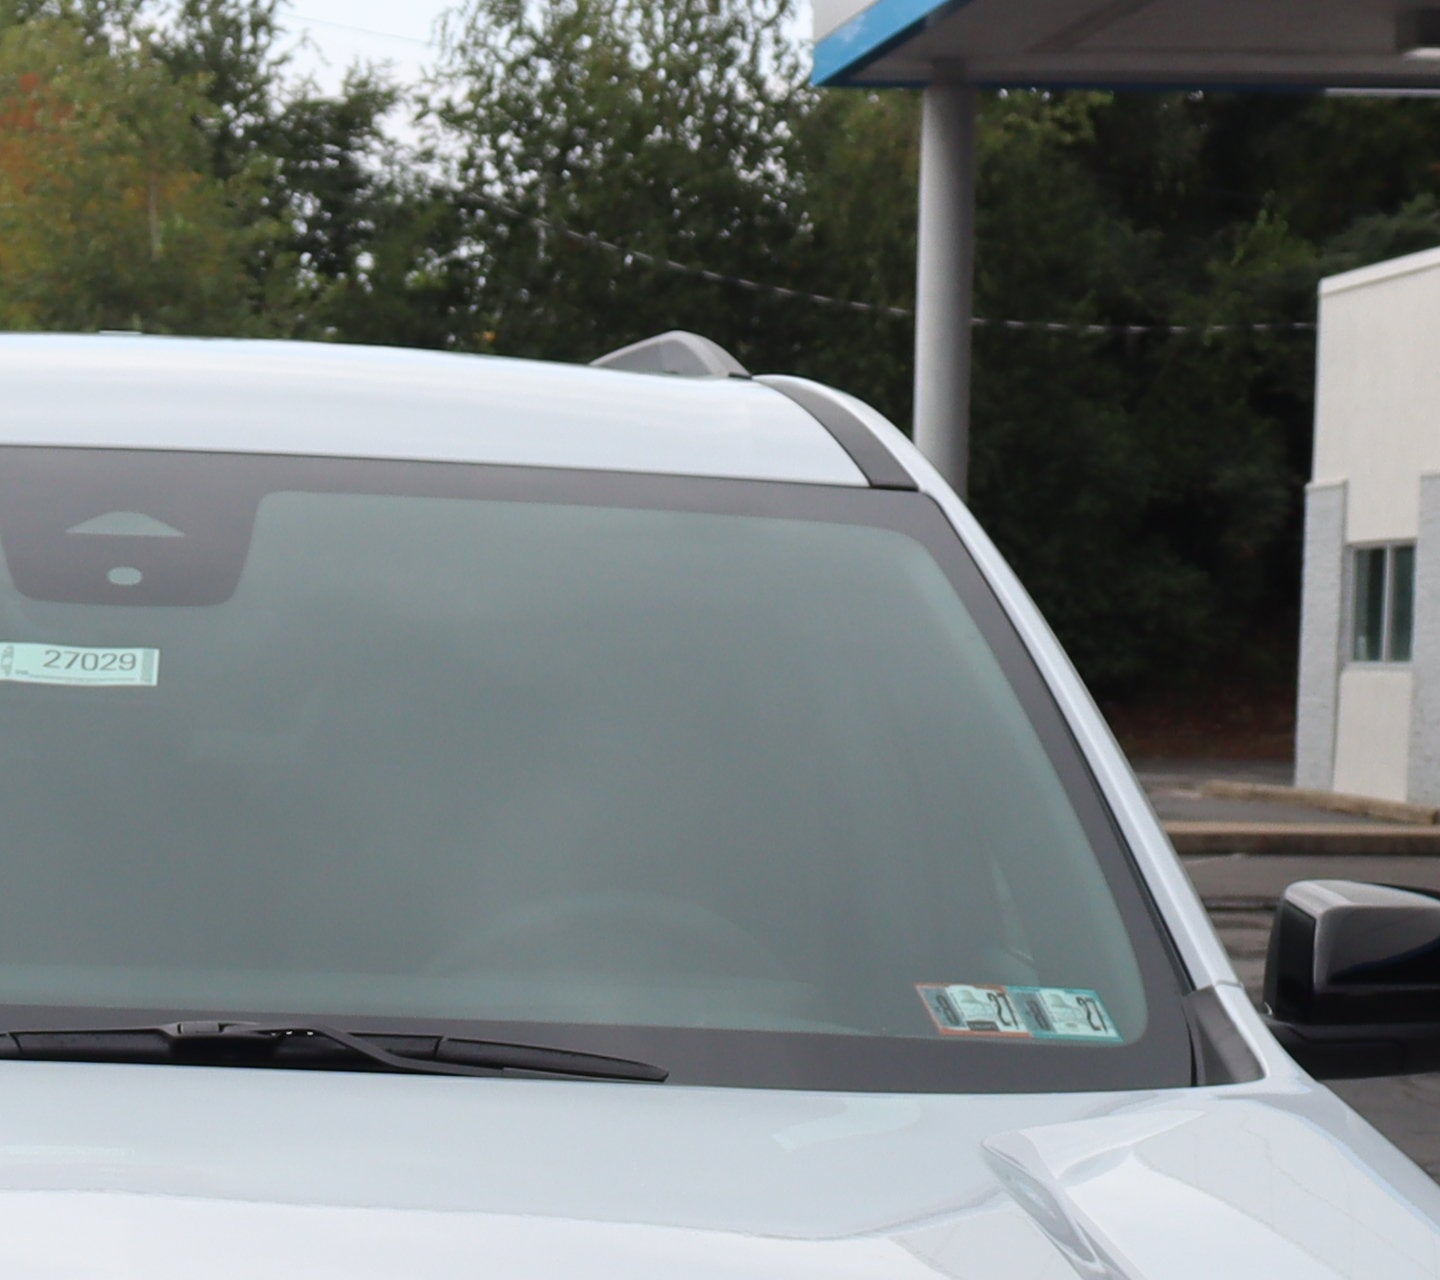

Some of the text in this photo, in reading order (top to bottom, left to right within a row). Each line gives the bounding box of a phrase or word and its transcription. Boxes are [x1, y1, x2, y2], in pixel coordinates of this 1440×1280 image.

[42, 649, 137, 672] 27029
[986, 991, 1019, 1029] 27
[1076, 996, 1108, 1034] 27
